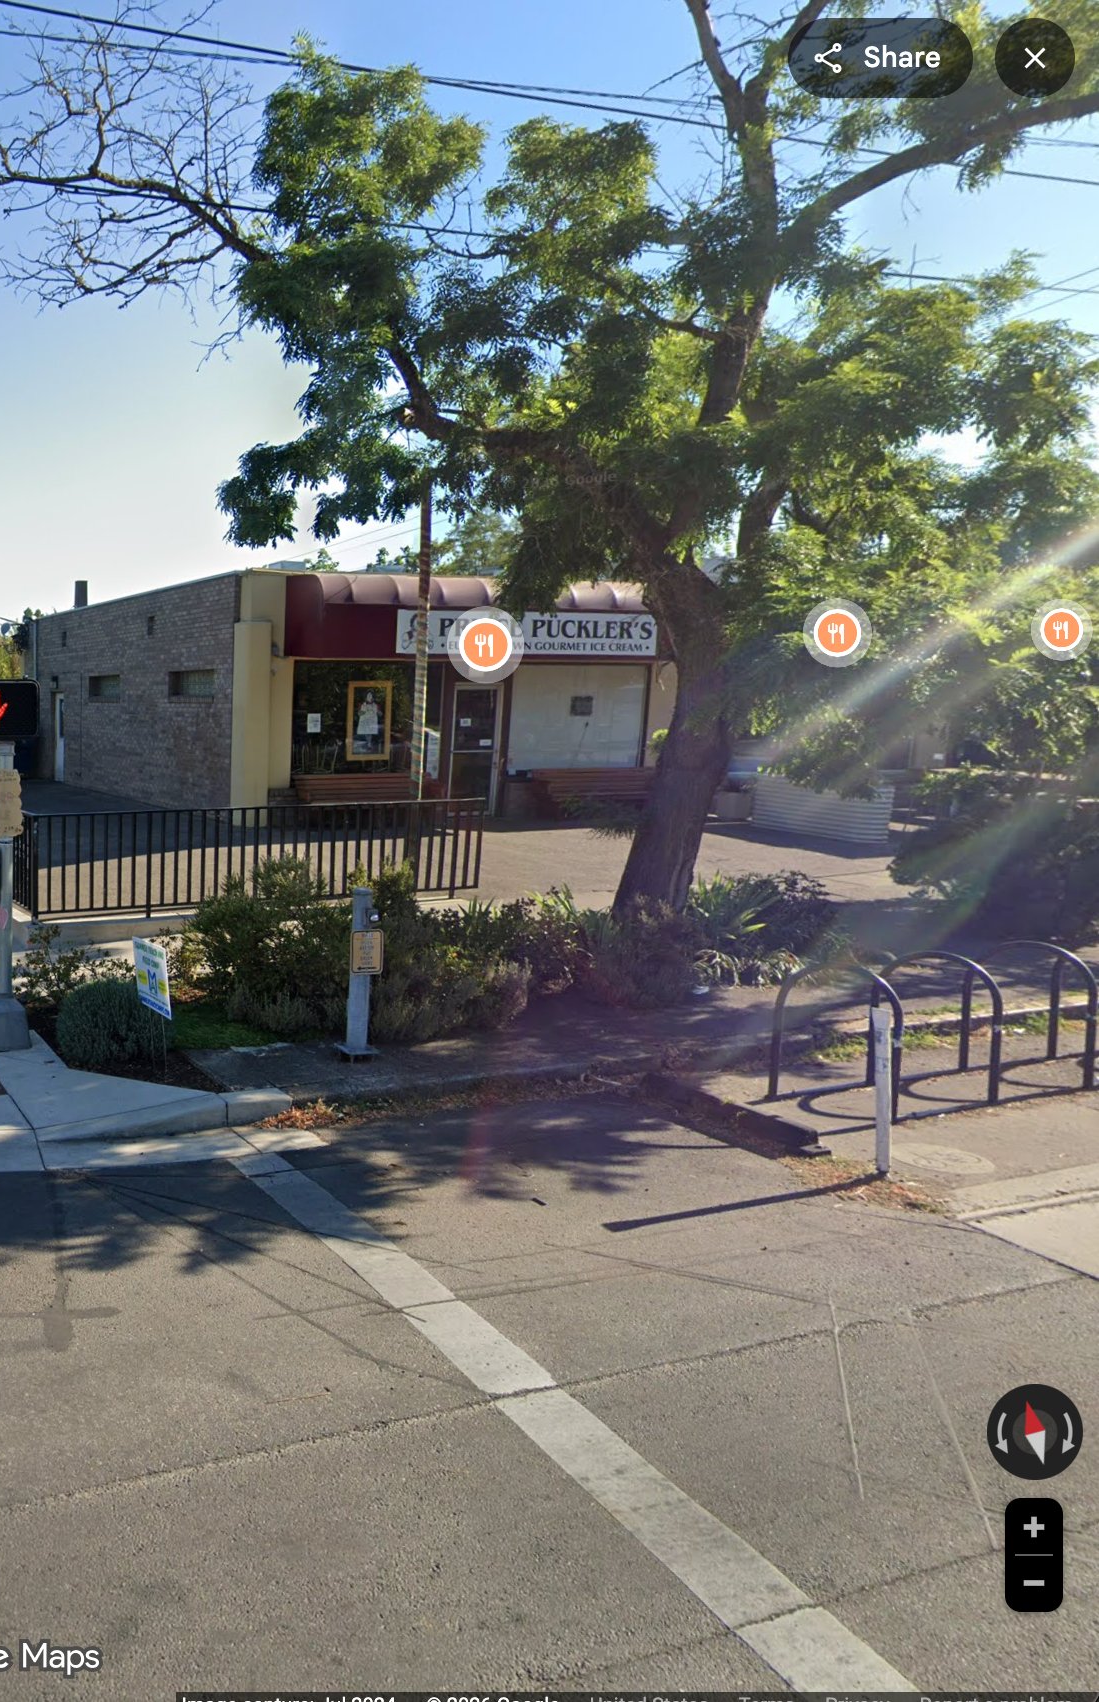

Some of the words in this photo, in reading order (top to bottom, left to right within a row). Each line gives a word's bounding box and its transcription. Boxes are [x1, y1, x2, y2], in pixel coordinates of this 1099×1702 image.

[439, 618, 522, 638] PRE
[534, 641, 586, 651] GOURMET
[590, 642, 605, 651] ICE
[608, 642, 643, 652] CREAM
